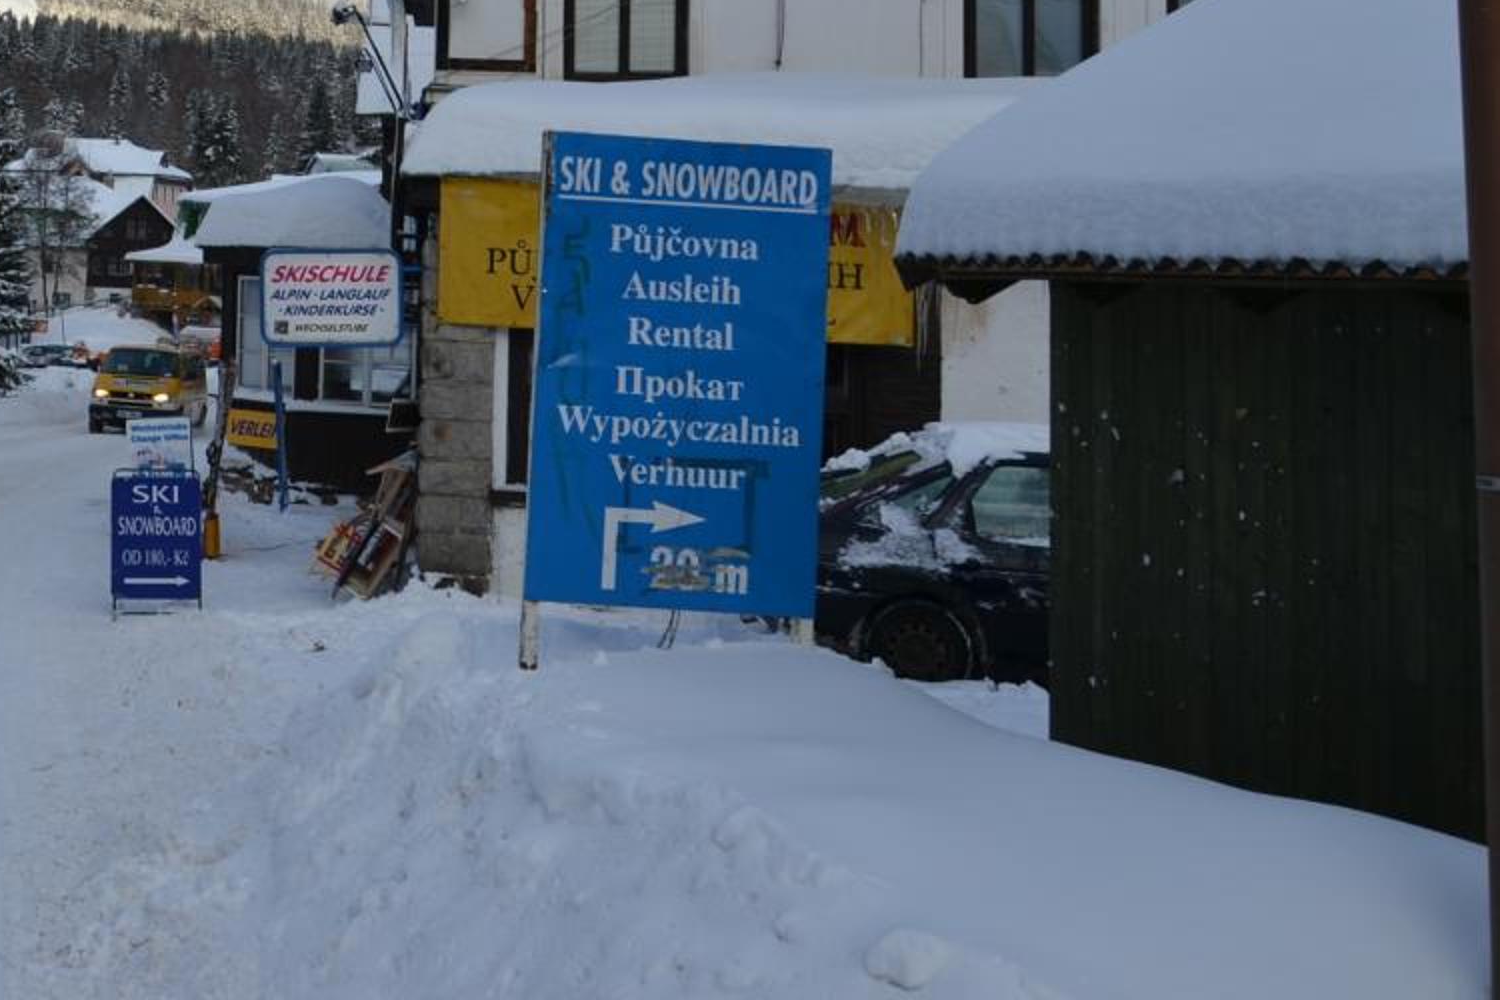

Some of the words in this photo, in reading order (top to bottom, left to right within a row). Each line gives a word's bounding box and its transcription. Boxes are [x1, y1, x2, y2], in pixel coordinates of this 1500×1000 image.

[560, 155, 600, 193] SKI
[611, 160, 631, 195] &
[641, 160, 818, 209] SNOWBOARD
[610, 223, 759, 262] Půjčovna
[271, 265, 389, 283] SKISCHULE
[621, 270, 741, 305] Ausleih
[295, 323, 369, 333] WECHSELSTUBE
[628, 317, 734, 350] Rental
[615, 365, 745, 403] Прокат
[231, 419, 276, 438] VERLEI
[557, 404, 802, 447] Wypożyczalnia
[608, 453, 747, 490] Verhuur
[132, 485, 180, 503] SKI
[118, 516, 197, 536] SNOWBOARD
[122, 549, 142, 566] OD
[714, 563, 749, 595] m
